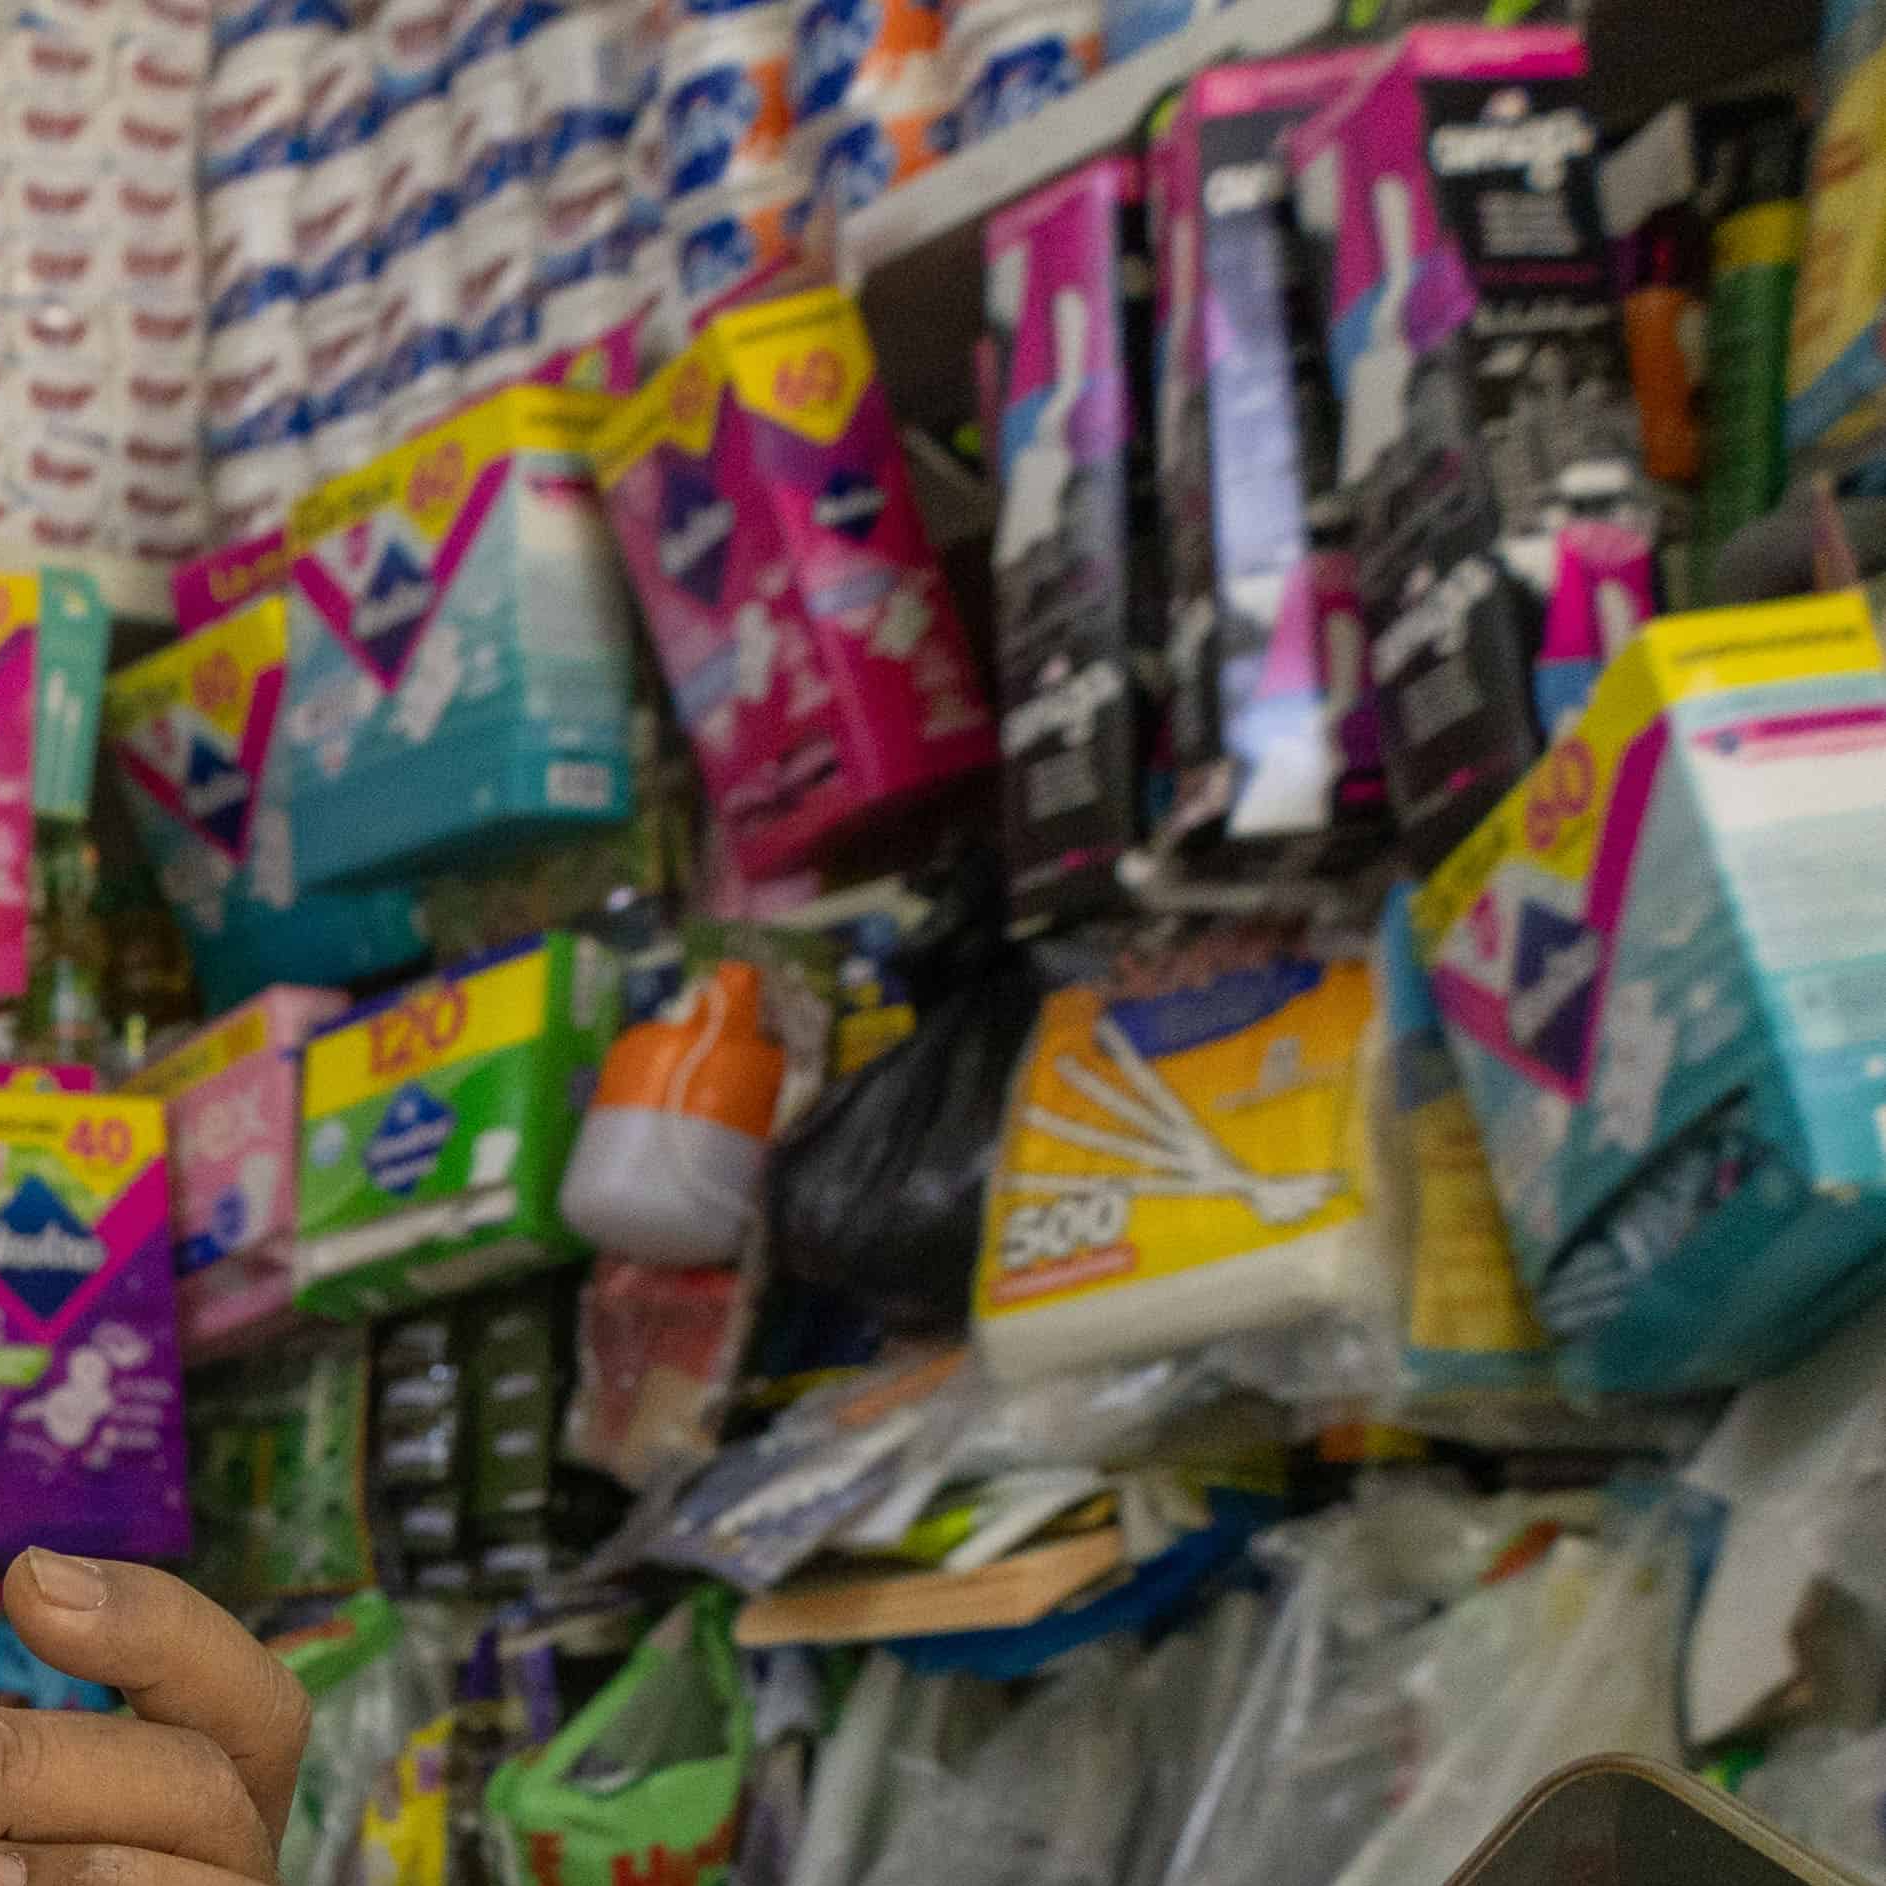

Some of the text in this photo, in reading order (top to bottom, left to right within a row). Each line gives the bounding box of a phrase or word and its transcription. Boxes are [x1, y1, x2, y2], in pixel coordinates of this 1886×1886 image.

[369, 979, 467, 1076] 120
[67, 1119, 133, 1163] 40
[1002, 1182, 1130, 1268] 500
